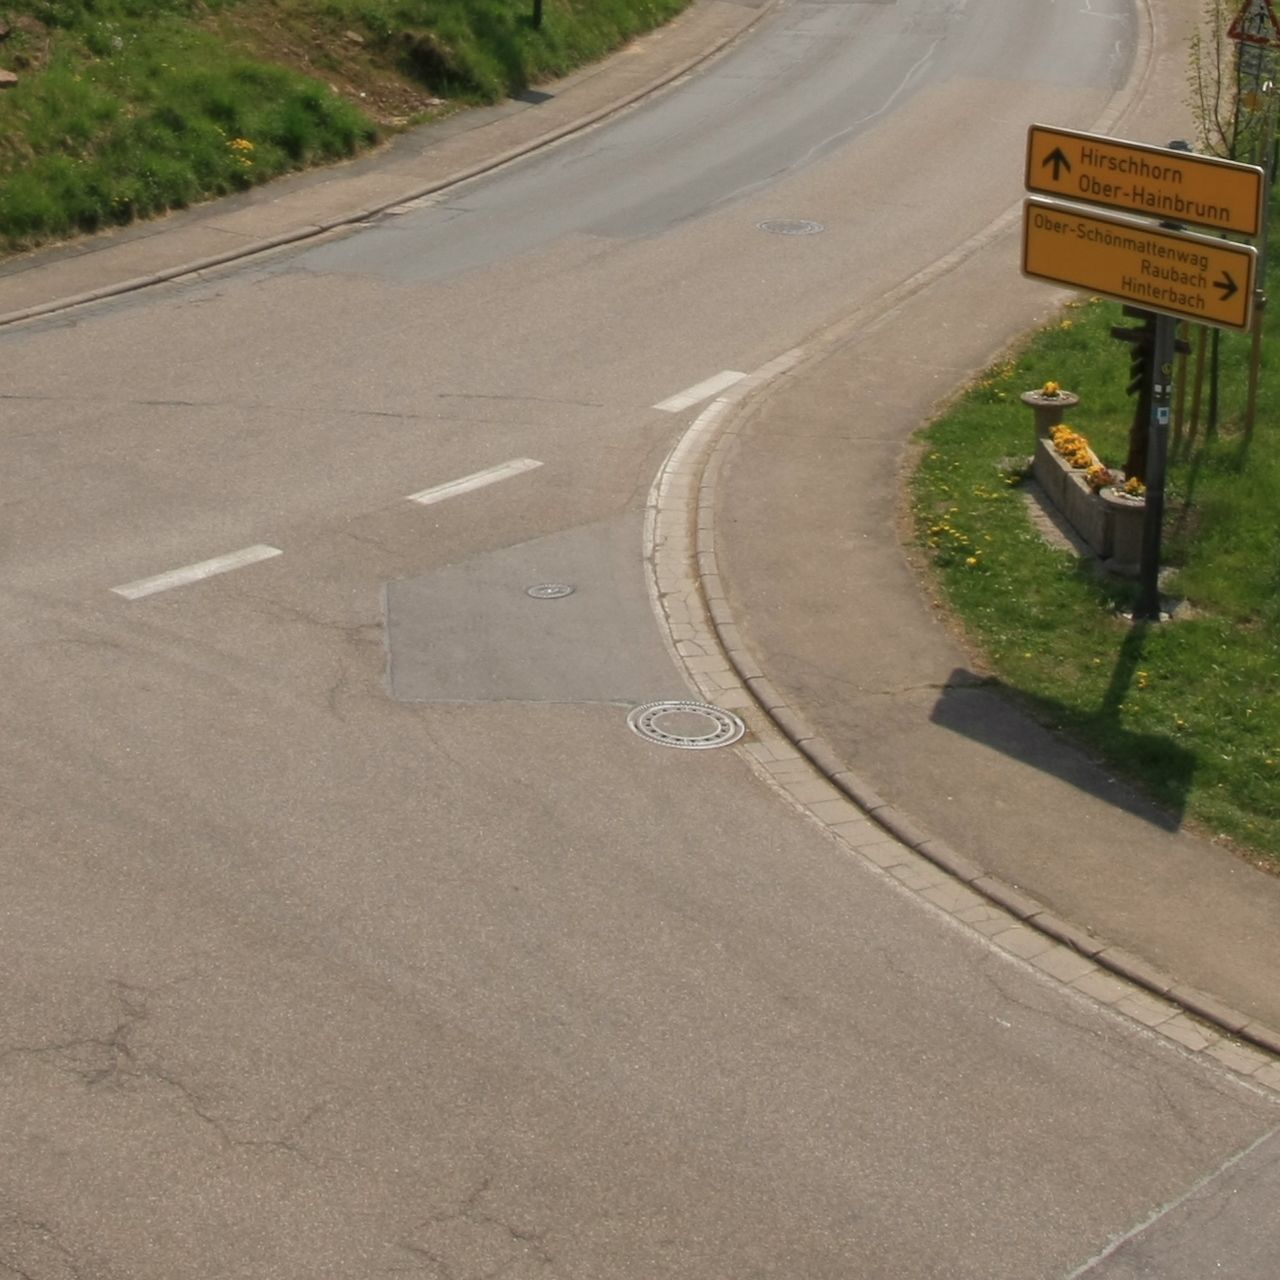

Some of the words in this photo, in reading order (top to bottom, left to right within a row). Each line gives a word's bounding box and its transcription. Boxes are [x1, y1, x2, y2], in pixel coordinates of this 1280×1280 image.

[1080, 146, 1183, 184] Hirschhorn
[1078, 174, 1230, 222] Ober-Hainbrunn
[1034, 213, 1209, 271] Ober-Schönmattenwag
[1121, 276, 1206, 310] Hinterbach
[1140, 259, 1207, 289] Raubach
